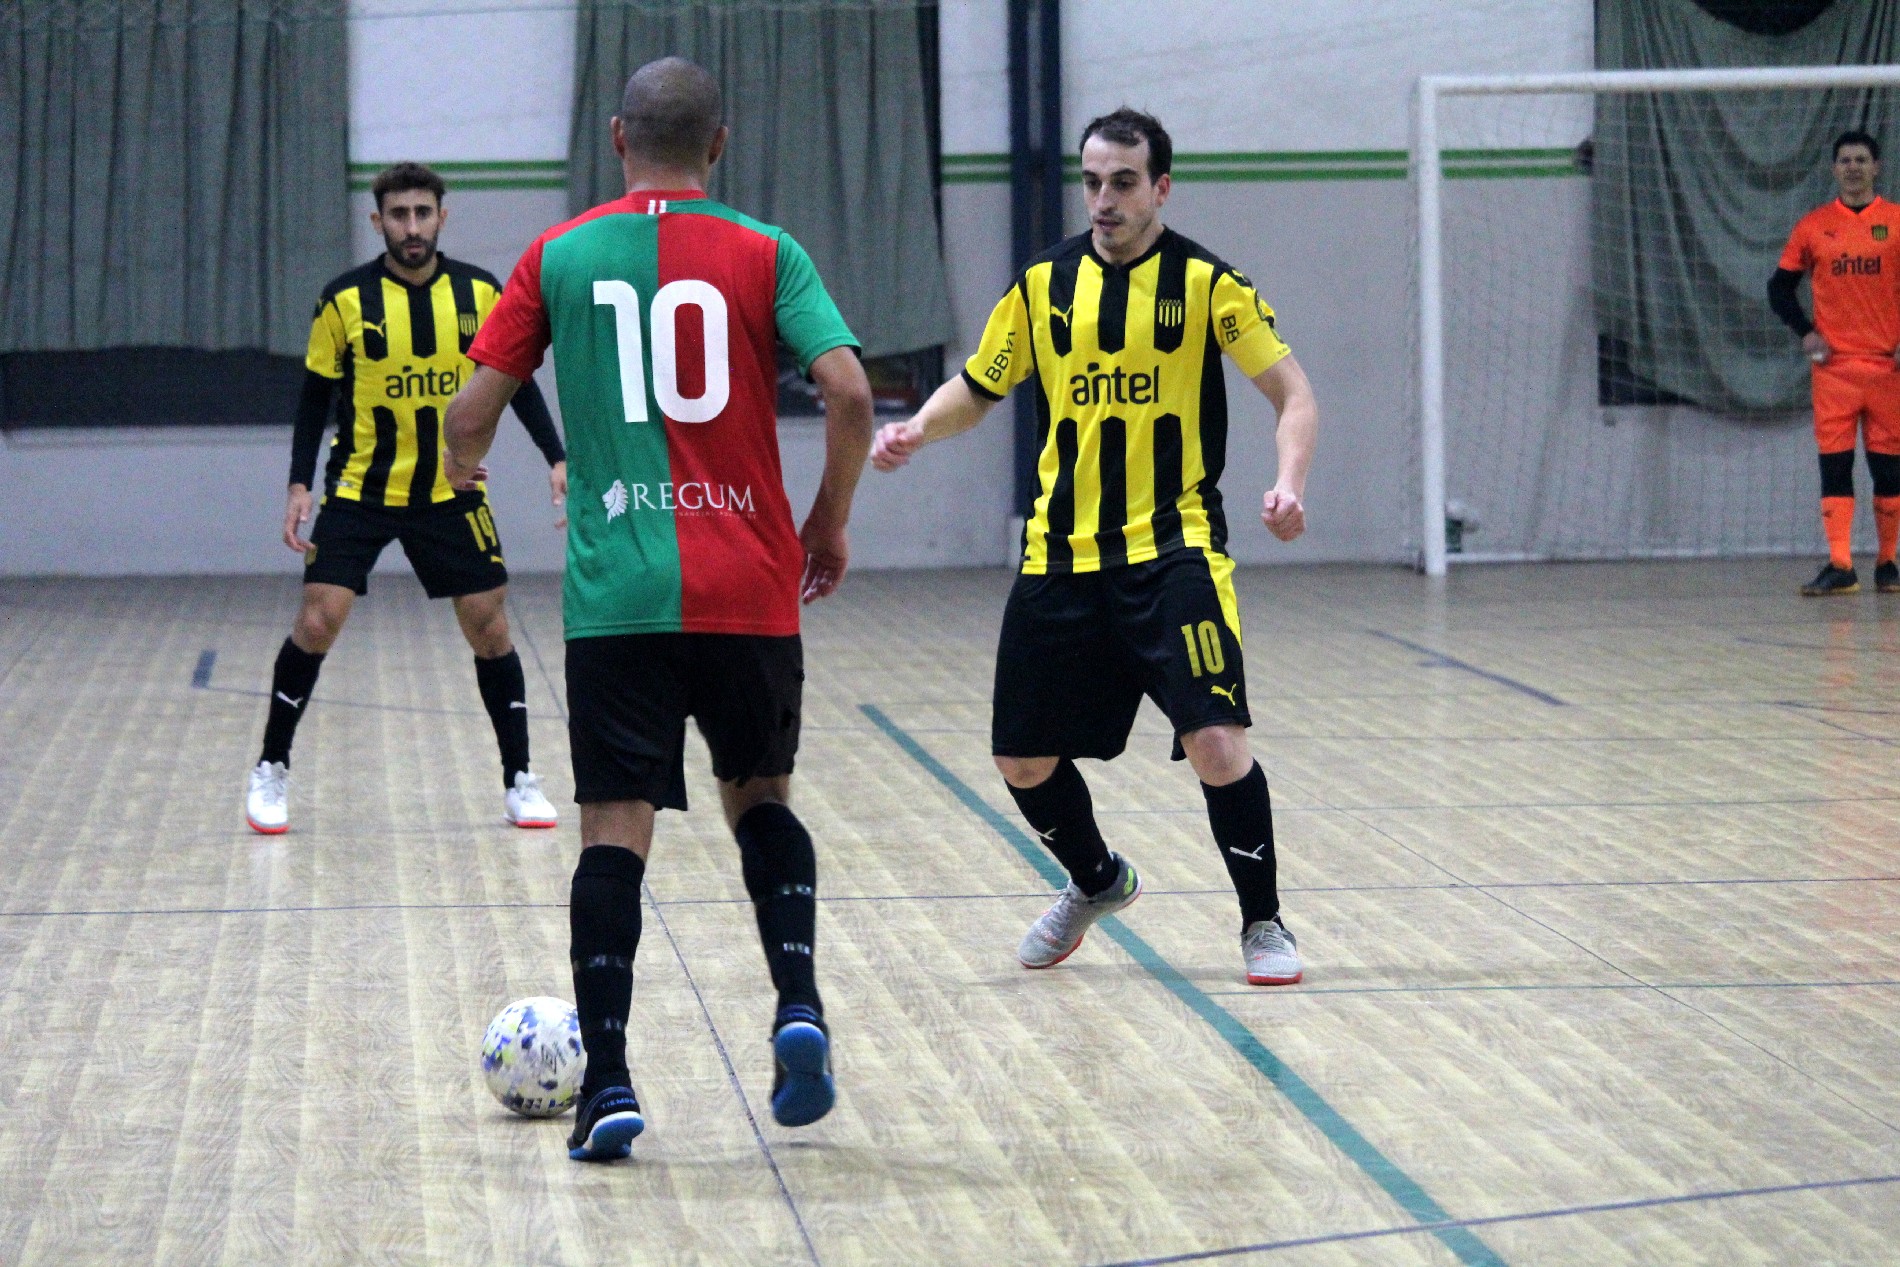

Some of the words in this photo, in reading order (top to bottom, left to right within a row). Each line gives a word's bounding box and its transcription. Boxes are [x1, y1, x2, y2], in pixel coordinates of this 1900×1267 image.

[1831, 252, 1882, 277] antel
[593, 279, 731, 424] 10
[385, 365, 460, 399] antel
[1070, 362, 1160, 405] antel
[631, 482, 756, 512] REGUM
[465, 505, 497, 552] 19
[1181, 620, 1225, 678] 10
